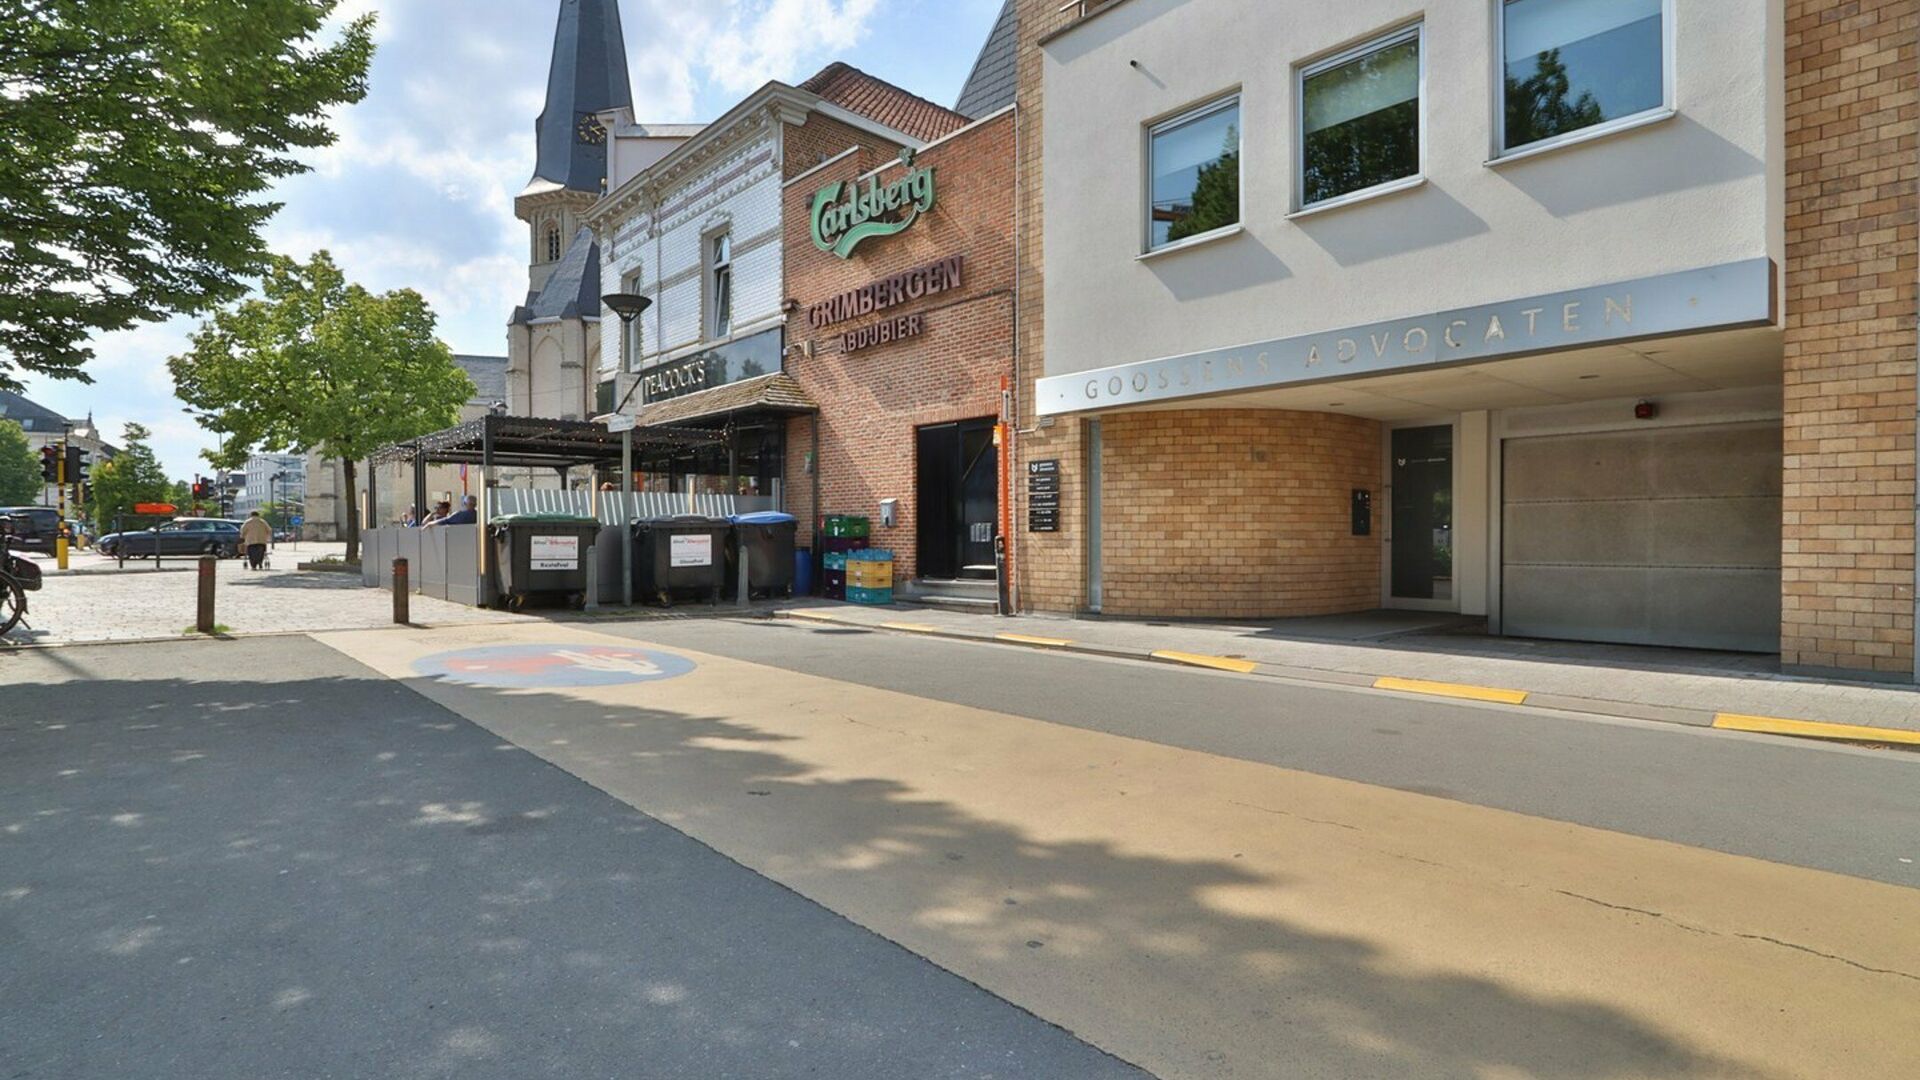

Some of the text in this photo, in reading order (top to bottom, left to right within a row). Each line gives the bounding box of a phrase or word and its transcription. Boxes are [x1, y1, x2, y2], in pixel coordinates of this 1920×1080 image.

[810, 166, 937, 258] Carlsberg
[807, 255, 963, 330] GRIMBERGEN
[1085, 294, 1633, 399] GOOSSENS ADVOCATEN
